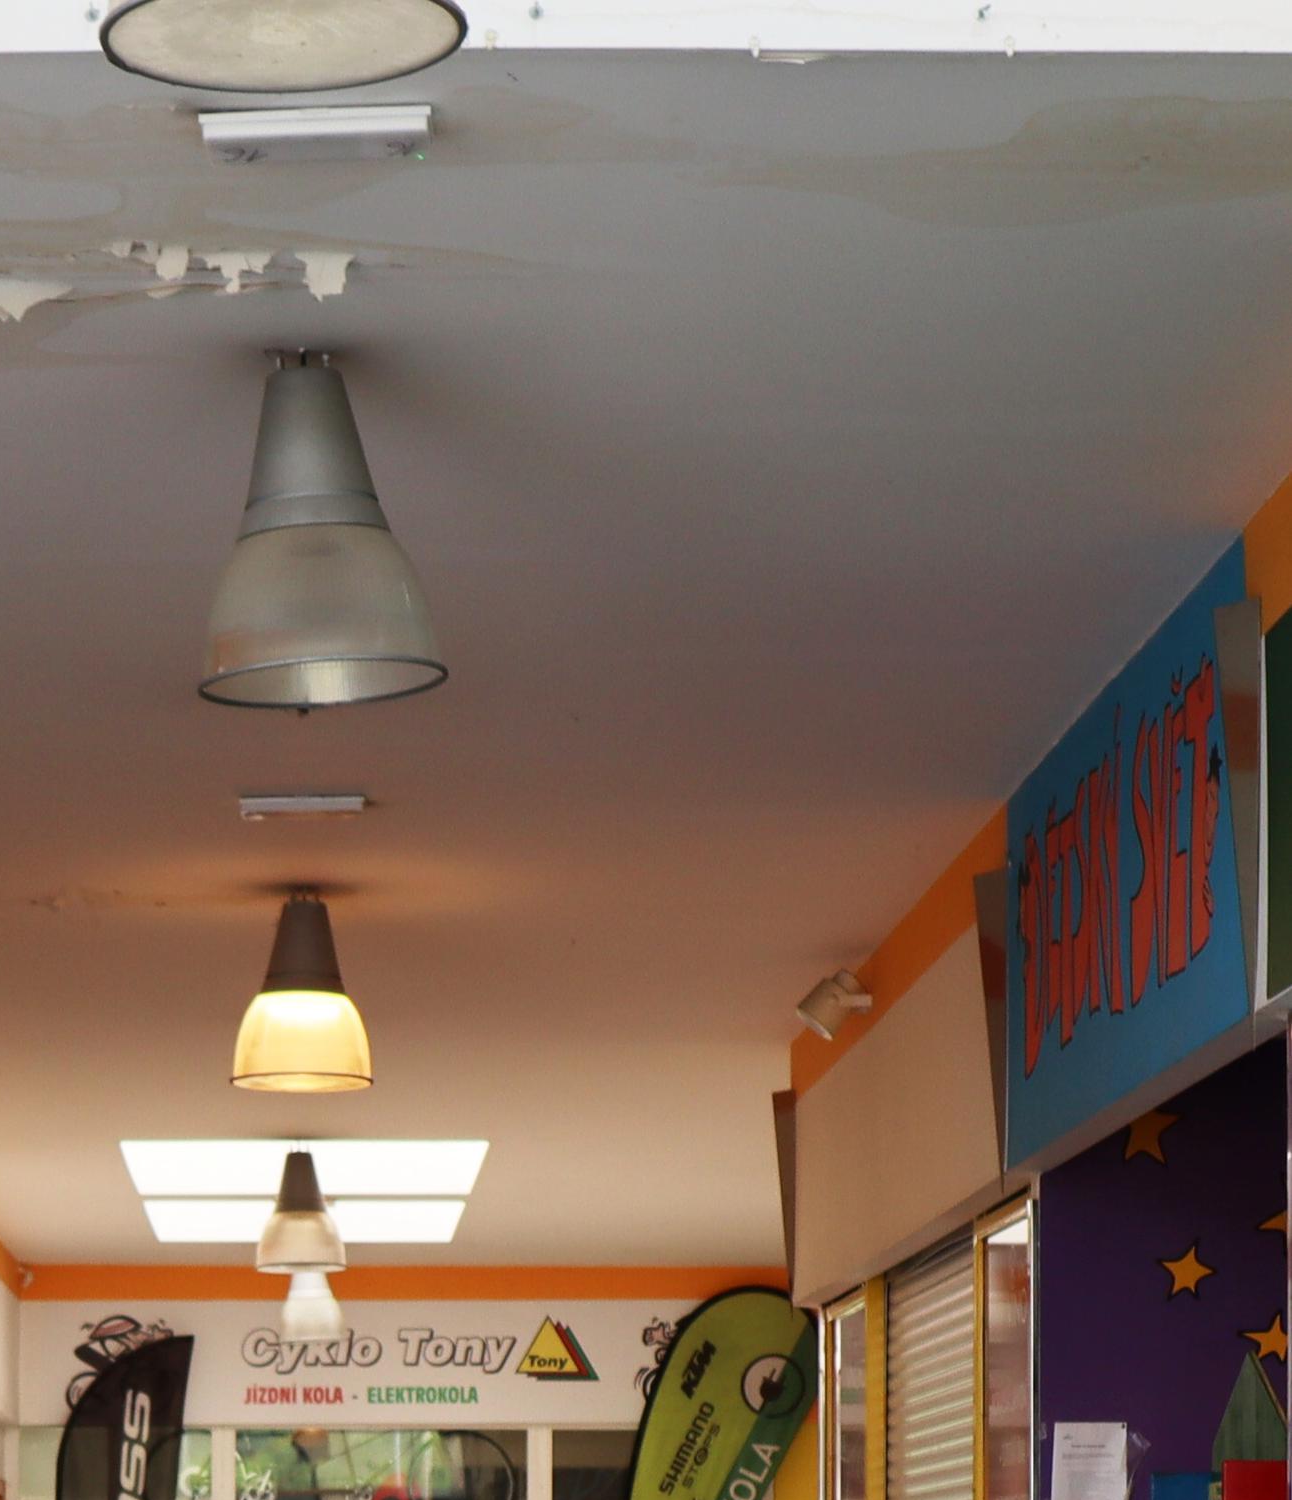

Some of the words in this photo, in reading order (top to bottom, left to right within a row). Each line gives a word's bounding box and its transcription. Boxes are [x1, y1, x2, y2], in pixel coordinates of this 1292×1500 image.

[1130, 652, 1215, 1009] SVĚT
[241, 1327, 383, 1375] Cyklo
[398, 1327, 518, 1375] Tony
[527, 1354, 569, 1370] Tony
[244, 1383, 298, 1405] JÍZDNÍ
[302, 1386, 344, 1405] KOLA
[366, 1386, 479, 1405] ELEKTROKOLA
[658, 1401, 716, 1497] SHIMANO
